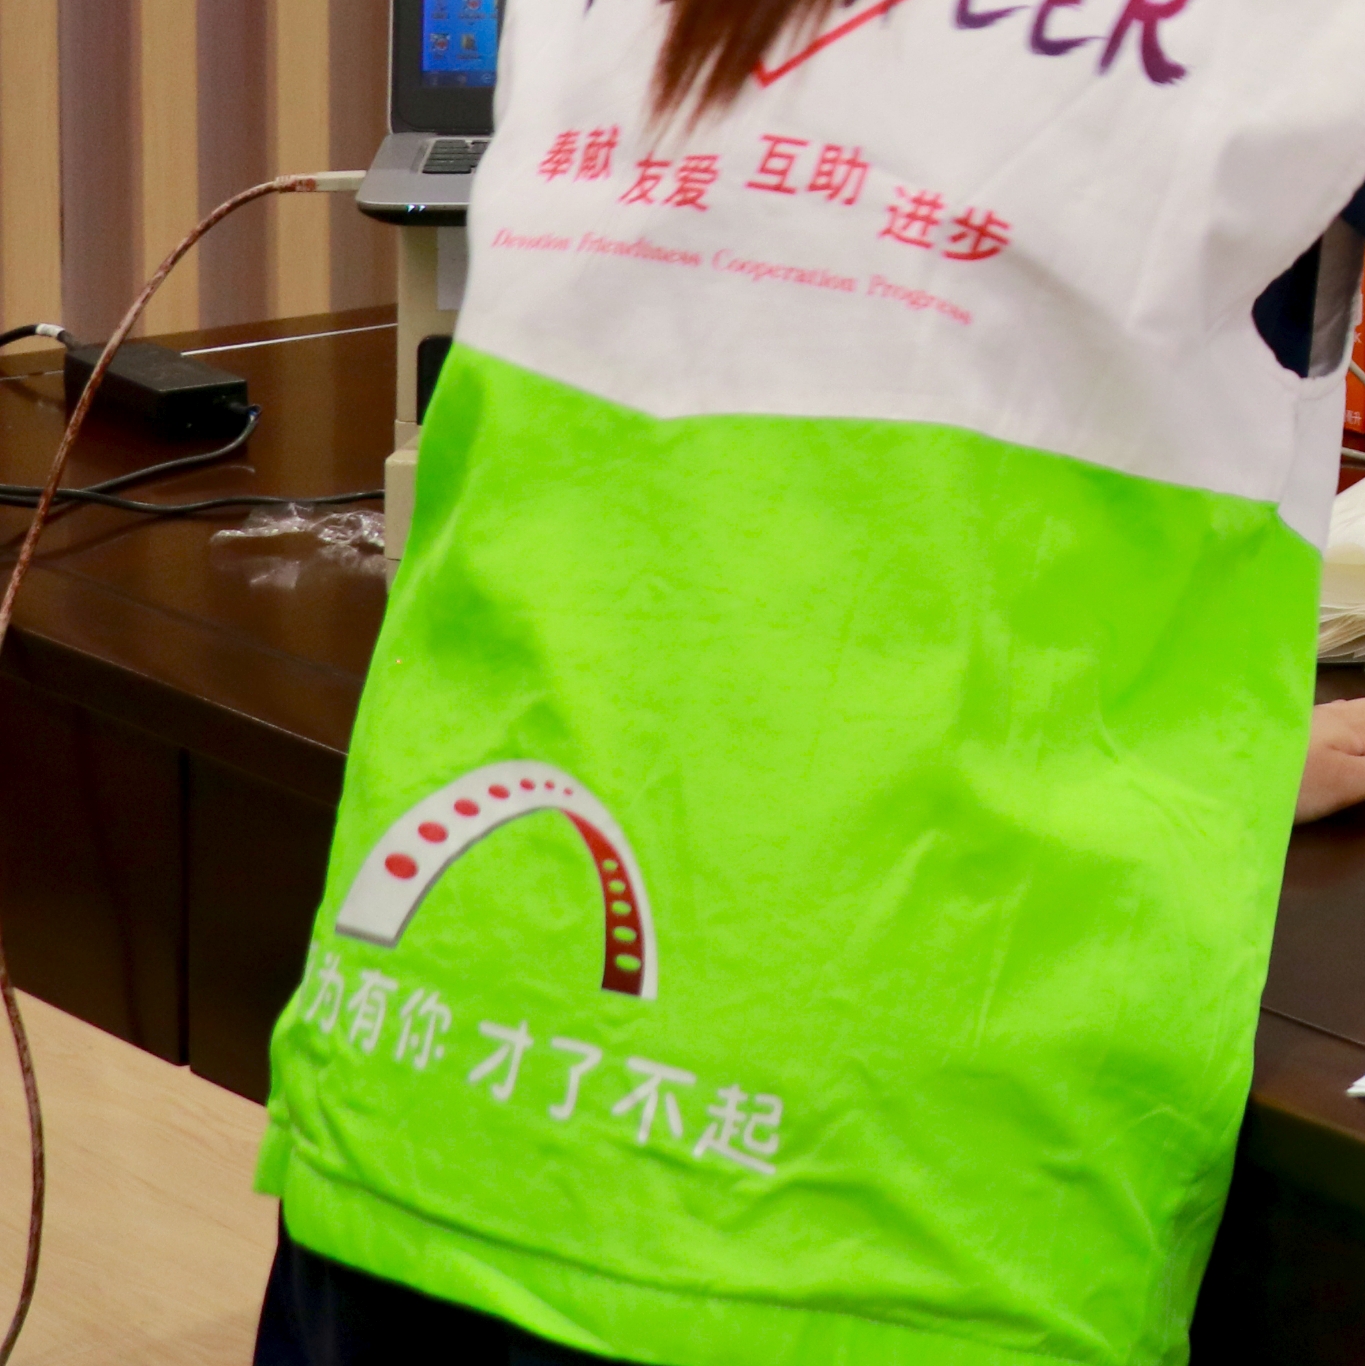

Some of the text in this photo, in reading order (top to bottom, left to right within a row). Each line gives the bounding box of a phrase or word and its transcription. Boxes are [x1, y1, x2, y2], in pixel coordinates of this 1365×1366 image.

[539, 126, 1012, 263] 奉献 友爱 互助 进步
[711, 248, 858, 293] Cooperation
[867, 273, 973, 326] Progress
[301, 940, 784, 1175] 为有你 才了不起
